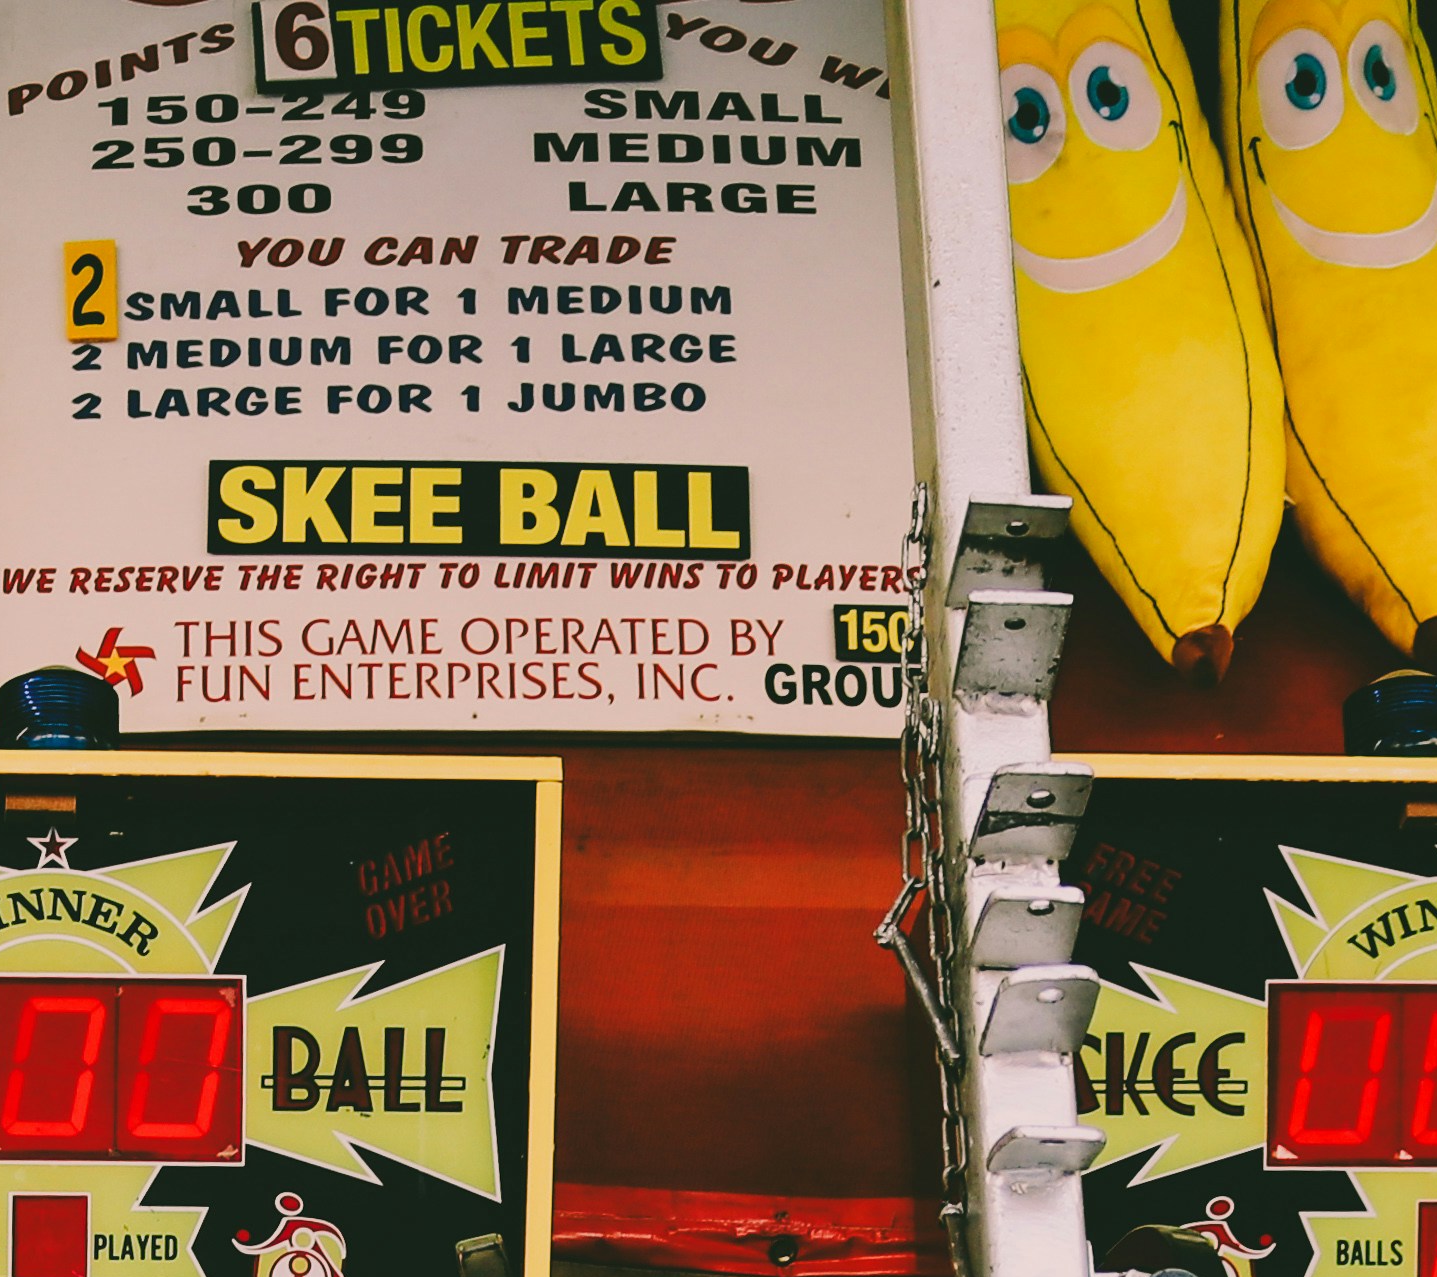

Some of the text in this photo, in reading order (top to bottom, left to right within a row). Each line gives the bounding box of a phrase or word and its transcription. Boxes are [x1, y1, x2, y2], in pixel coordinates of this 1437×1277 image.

[274, 0, 648, 75] 6 TICKETS
[666, 12, 799, 66] YOU
[7, 23, 236, 116] POINTS
[97, 88, 844, 127] 150-249 SMALL
[91, 132, 862, 170] 250-299 MEDIUM
[186, 181, 818, 216] 300 LARGE
[237, 234, 678, 268] YOU CAN TRADE
[71, 252, 733, 328] 2 SMALL FOR 1 MEDIUM
[71, 333, 738, 371] 2 MEDIUM FOR 1 LARGE
[71, 382, 707, 420] 2 LARGE FOR 1 JUMBO
[217, 465, 740, 549] SKEE BALL
[1, 567, 58, 595] WE
[68, 565, 225, 595] RESERVE
[237, 563, 304, 591] THE
[316, 562, 426, 592] RIGHT
[438, 562, 480, 590] TO
[493, 562, 598, 589] LIMIT
[609, 562, 701, 590] WINS
[716, 562, 758, 590] TO
[174, 617, 785, 657] THIS GAME OPERATED BY
[176, 661, 735, 705] FUN ENTERPRISES, INC.
[358, 831, 455, 897] GAME
[366, 879, 454, 940] OVER
[261, 1025, 466, 1114] BALL
[93, 1233, 179, 1262] PLAYED
[1336, 1239, 1404, 1266] BALLS
